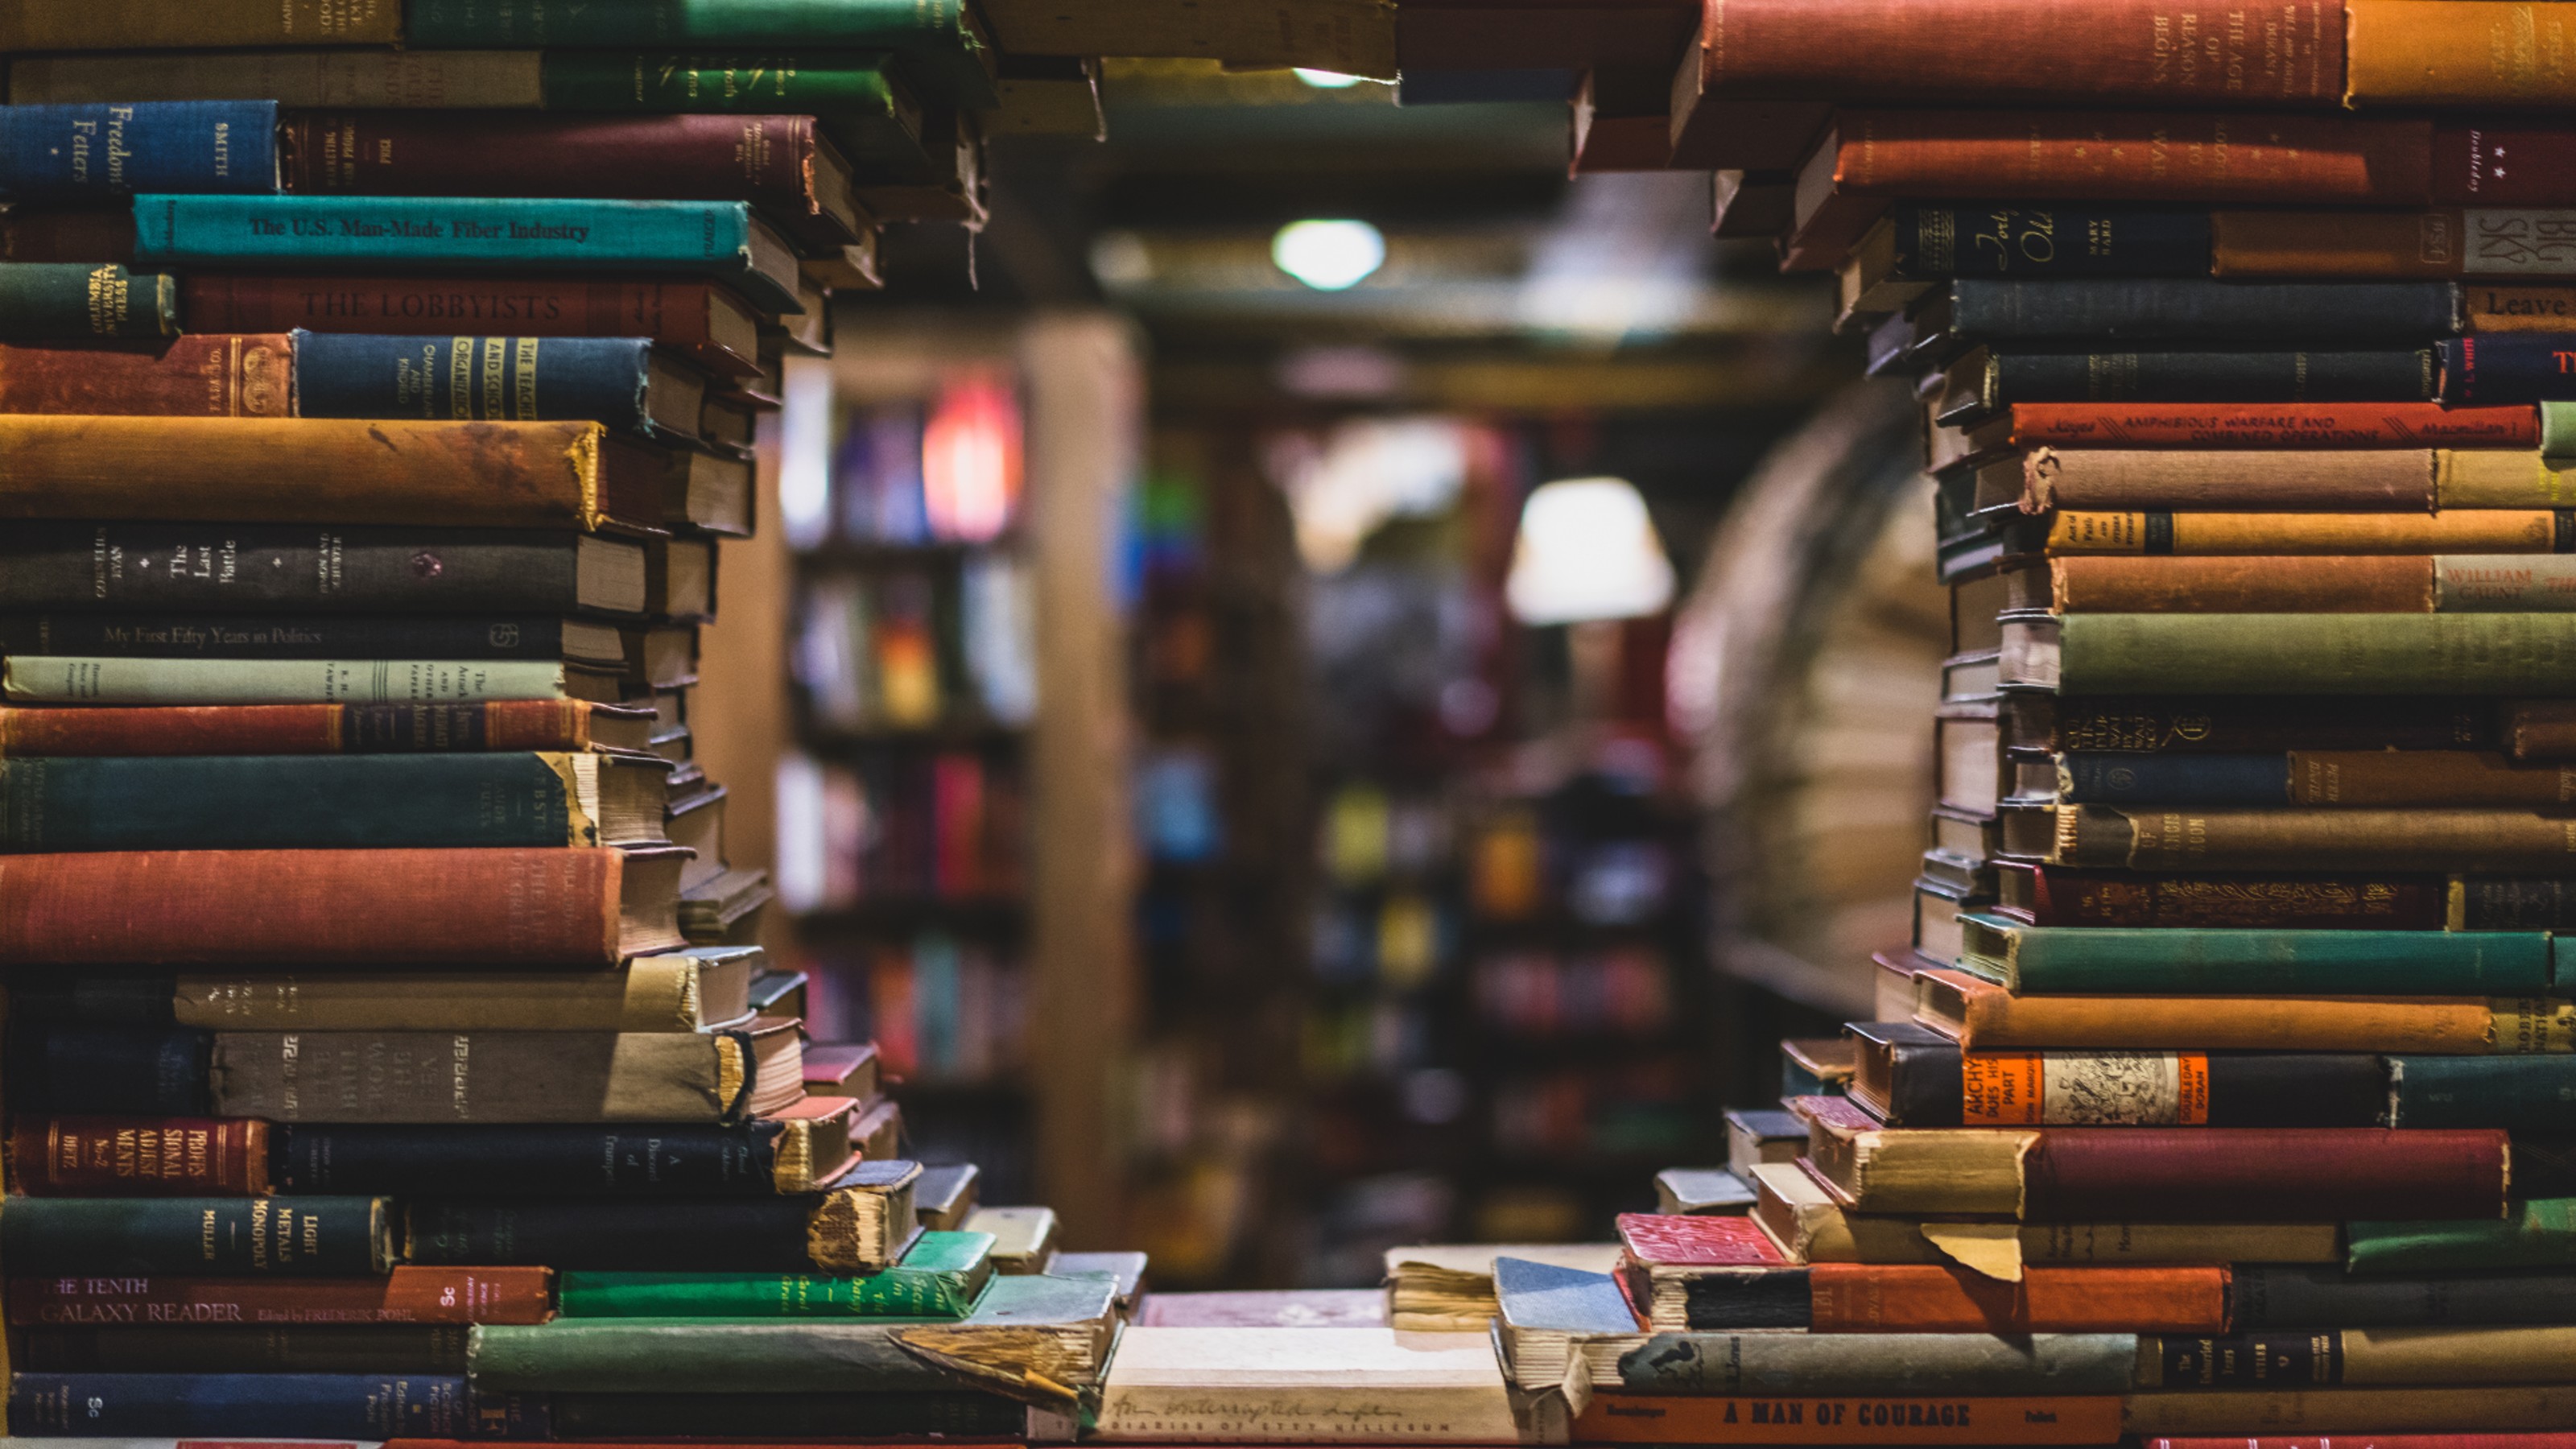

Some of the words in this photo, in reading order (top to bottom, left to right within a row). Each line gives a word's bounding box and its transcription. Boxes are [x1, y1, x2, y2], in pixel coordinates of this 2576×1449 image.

[2227, 11, 2244, 47] THE
[2283, 6, 2297, 37] WILL
[2153, 16, 2171, 85] BEGINS
[2180, 14, 2198, 87] REASON
[2205, 36, 2219, 63] OF
[2264, 23, 2279, 78] DURANT
[2227, 53, 2244, 91] AGE
[71, 119, 97, 184] Fetters
[214, 122, 229, 177] SMITH
[378, 138, 392, 165] PRICE
[2150, 129, 2168, 182] WAR
[2467, 130, 2483, 193] Doubleday
[250, 218, 286, 237] The
[292, 219, 333, 237] U.S.
[340, 220, 443, 239] Man-Made
[452, 220, 501, 240] Fiber
[507, 221, 590, 243] Industry
[1975, 206, 2020, 272] Forty
[2019, 211, 2054, 263] Odd
[2088, 220, 2099, 257] MARY
[2100, 219, 2112, 257] BARD
[2478, 217, 2533, 264] SKY
[2535, 220, 2576, 262] BIG
[88, 267, 102, 334] COLUMBIA
[99, 263, 118, 336] UNIVERSITY
[114, 279, 128, 322] PRESS
[300, 291, 369, 317] THE
[381, 291, 560, 320] LOBBYISTS
[2486, 292, 2567, 316] Leave
[487, 344, 501, 371] AND
[518, 344, 535, 365] THE
[409, 369, 421, 394] AND
[2123, 415, 2219, 430] AMPHIBIOUS
[2224, 415, 2297, 429] WARFARE
[2300, 415, 2335, 429] AND
[2190, 428, 2275, 444] COMBINED
[2279, 427, 2380, 444] OPERATIONS
[2083, 517, 2094, 542] Faith
[109, 545, 123, 579] RYAN
[169, 544, 188, 579] The
[192, 545, 212, 579] Last
[218, 539, 237, 584] Battle
[2447, 568, 2533, 587] WILLIAM
[2458, 586, 2523, 601] GAUNT
[104, 626, 133, 645] My
[135, 626, 167, 642] First
[171, 626, 206, 646] Fifty
[211, 626, 247, 643] Years
[252, 628, 267, 642] in
[271, 627, 321, 643] Politics
[425, 663, 436, 699] OTHER
[440, 671, 449, 692] AND
[457, 665, 469, 699] Attack
[475, 669, 487, 692] The
[1986, 1058, 2000, 1080] HIS
[2025, 1054, 2035, 1099] MARQUIS
[1967, 1059, 1984, 1115] ARCHY
[1987, 1086, 2000, 1118] DOES
[2001, 1071, 2016, 1106] PART
[2182, 1057, 2193, 1122] DOUBLEDAY
[2194, 1071, 2206, 1110] DORAN
[2025, 1103, 2035, 1124] DON
[62, 1134, 79, 1169] DIETZ
[116, 1128, 135, 1178] MENTS
[139, 1129, 159, 1176] ADJUST
[163, 1128, 184, 1179] SIONAL
[626, 1154, 639, 1166] of
[647, 1137, 663, 1182] Discord
[202, 1209, 216, 1261] MULLER
[251, 1199, 270, 1269] MONOPOLY
[276, 1208, 293, 1262] METALS
[303, 1215, 319, 1255] LIGHT
[85, 1278, 149, 1294] TENTH
[440, 1286, 456, 1307] Sc
[846, 1275, 866, 1314] Daisy
[893, 1282, 907, 1297] in
[40, 1302, 139, 1322] GALAXY
[147, 1302, 242, 1322] READER
[376, 1308, 415, 1322] POHL
[2178, 1354, 2191, 1372] The
[2223, 1348, 2235, 1375] Years
[2255, 1343, 2267, 1379] BUTLER
[86, 1396, 104, 1418] Sc
[429, 1385, 440, 1432] FICTION
[443, 1382, 452, 1434] SCIENCE
[510, 1396, 522, 1423] THE
[1723, 1403, 1738, 1424] A
[1751, 1403, 1804, 1425] MAN
[1815, 1404, 1847, 1426] OF
[1857, 1404, 1971, 1427] COURAGE
[1110, 1422, 1204, 1431] DIARIES
[1220, 1422, 1240, 1431] OF
[1261, 1422, 1317, 1432] ETTY
[1335, 1422, 1451, 1433] HILLESUM
